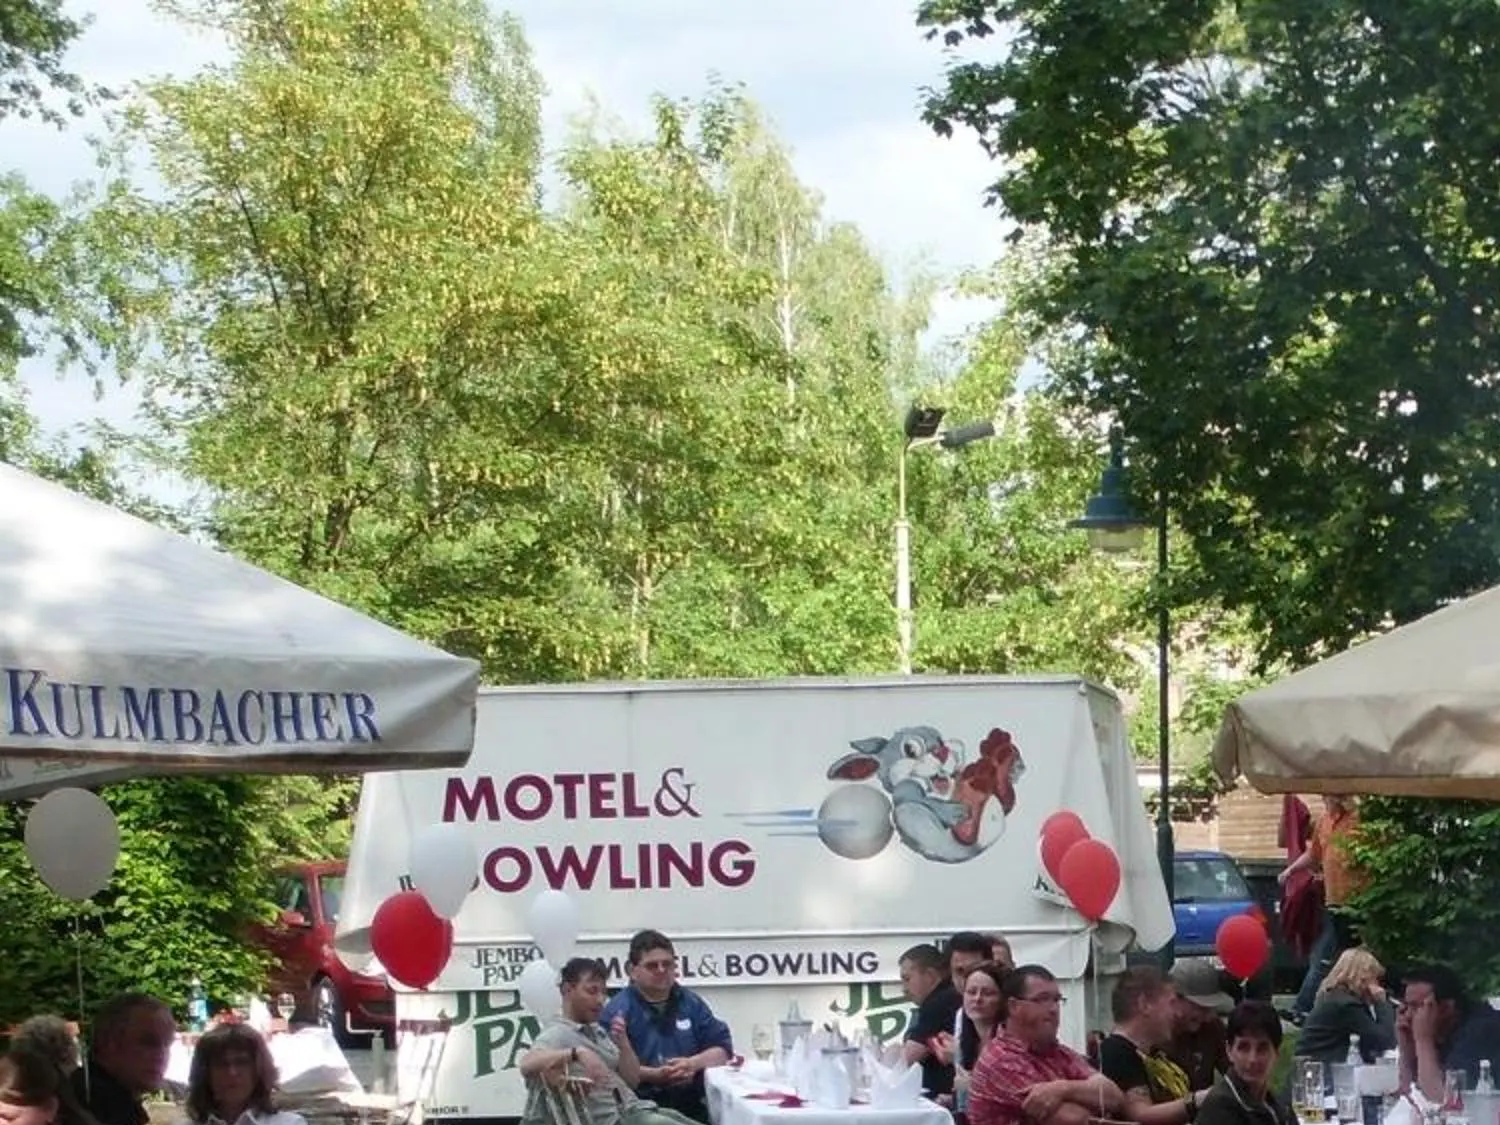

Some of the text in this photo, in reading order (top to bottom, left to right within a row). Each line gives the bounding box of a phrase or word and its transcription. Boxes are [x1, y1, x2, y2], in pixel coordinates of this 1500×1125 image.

[4, 667, 382, 745] KULMBACHER
[470, 840, 756, 893] OWLING
[483, 964, 525, 987] PAR
[725, 951, 879, 977] BOWLING
